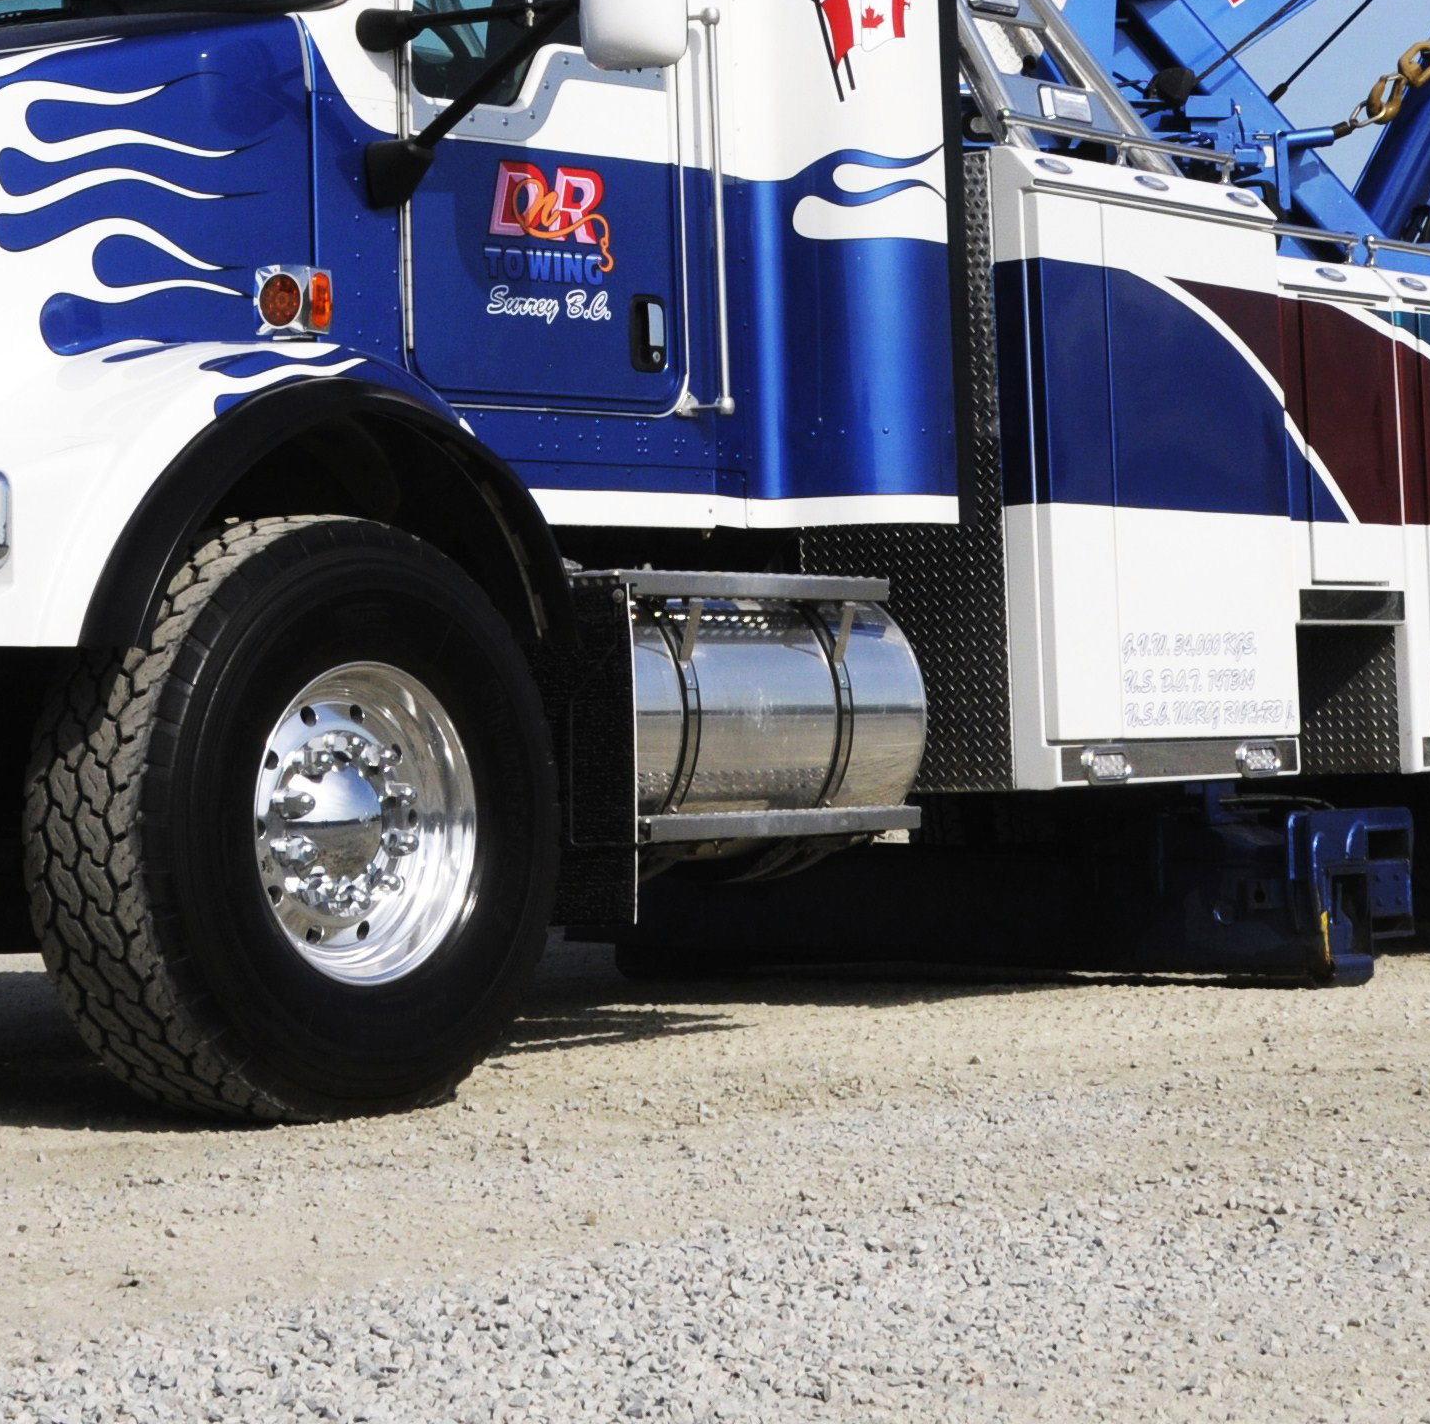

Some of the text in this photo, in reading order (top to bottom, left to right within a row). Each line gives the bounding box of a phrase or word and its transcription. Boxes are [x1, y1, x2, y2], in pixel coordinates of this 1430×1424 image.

[483, 245, 604, 286] TOWING
[486, 284, 612, 325] Surrey B.C.
